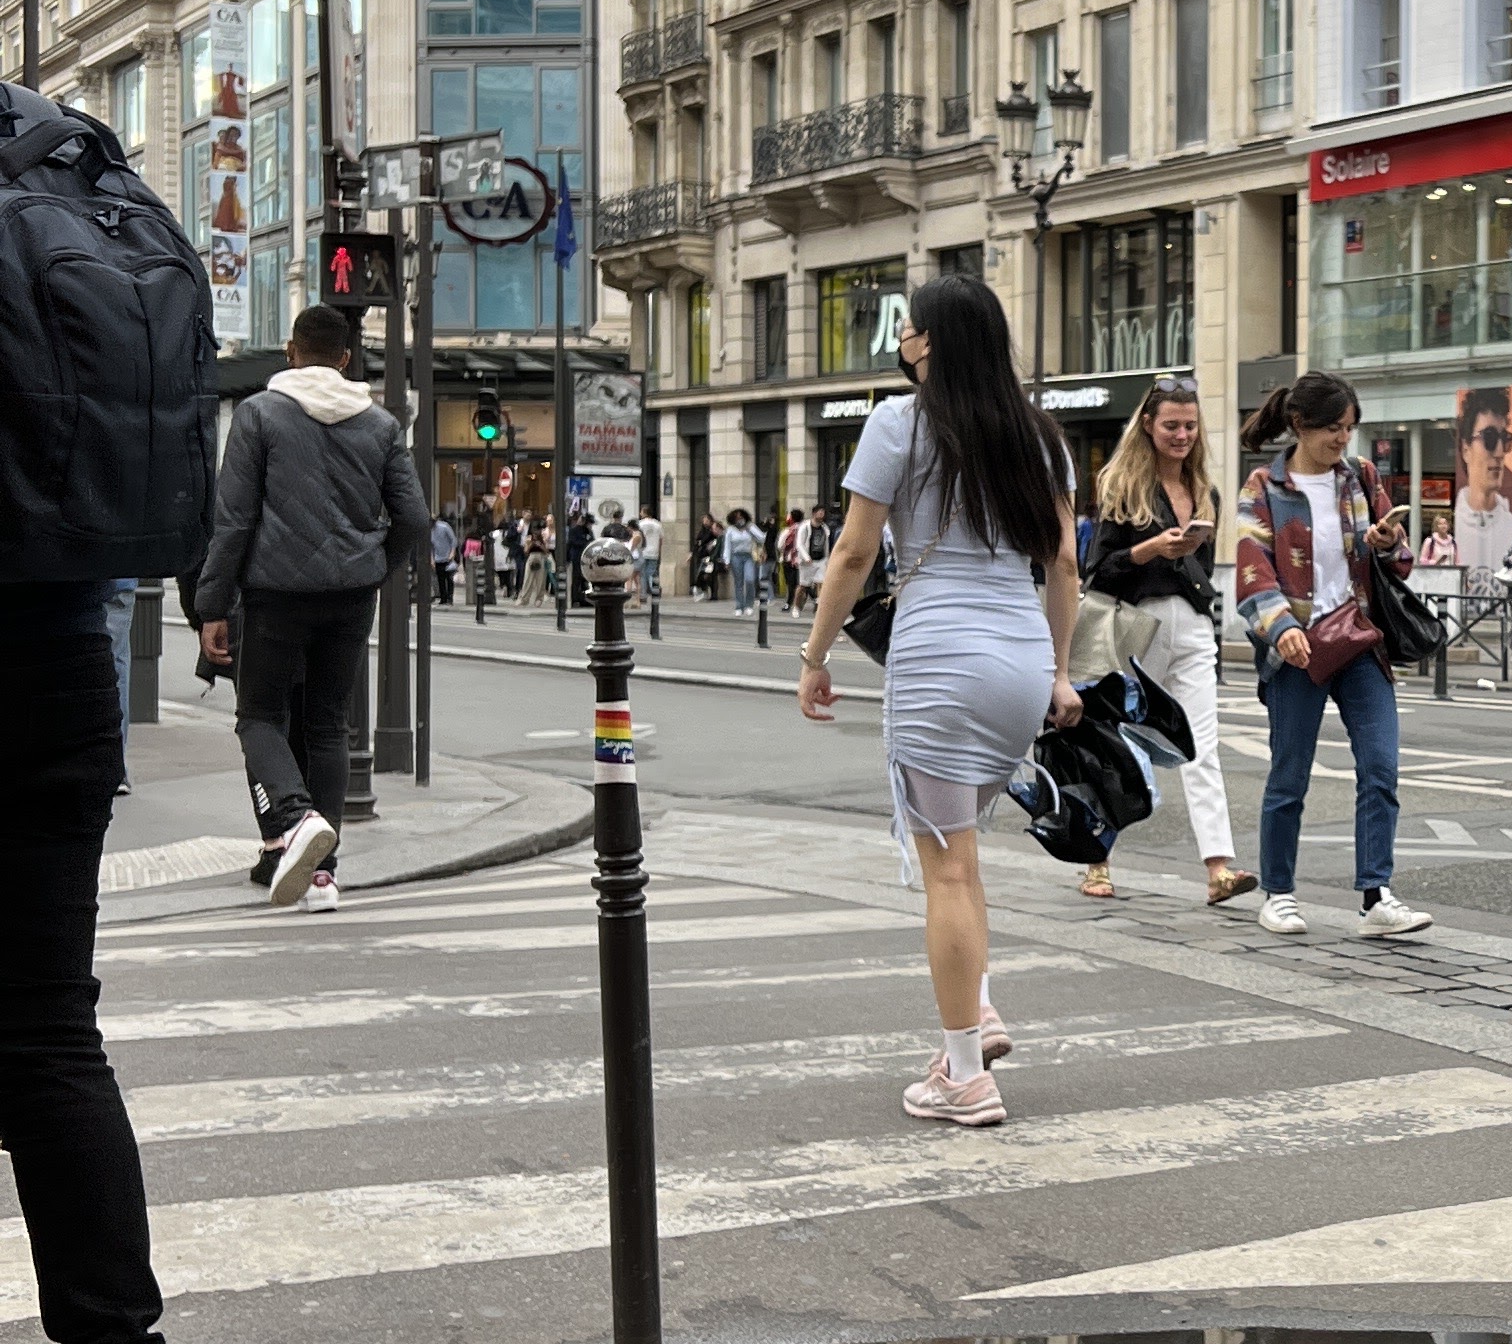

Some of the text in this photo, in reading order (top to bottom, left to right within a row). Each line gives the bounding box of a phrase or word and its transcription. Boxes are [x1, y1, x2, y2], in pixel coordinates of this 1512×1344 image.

[1321, 149, 1391, 185] Solaire
[870, 293, 910, 357] JD
[1029, 387, 1111, 410] cDonald's
